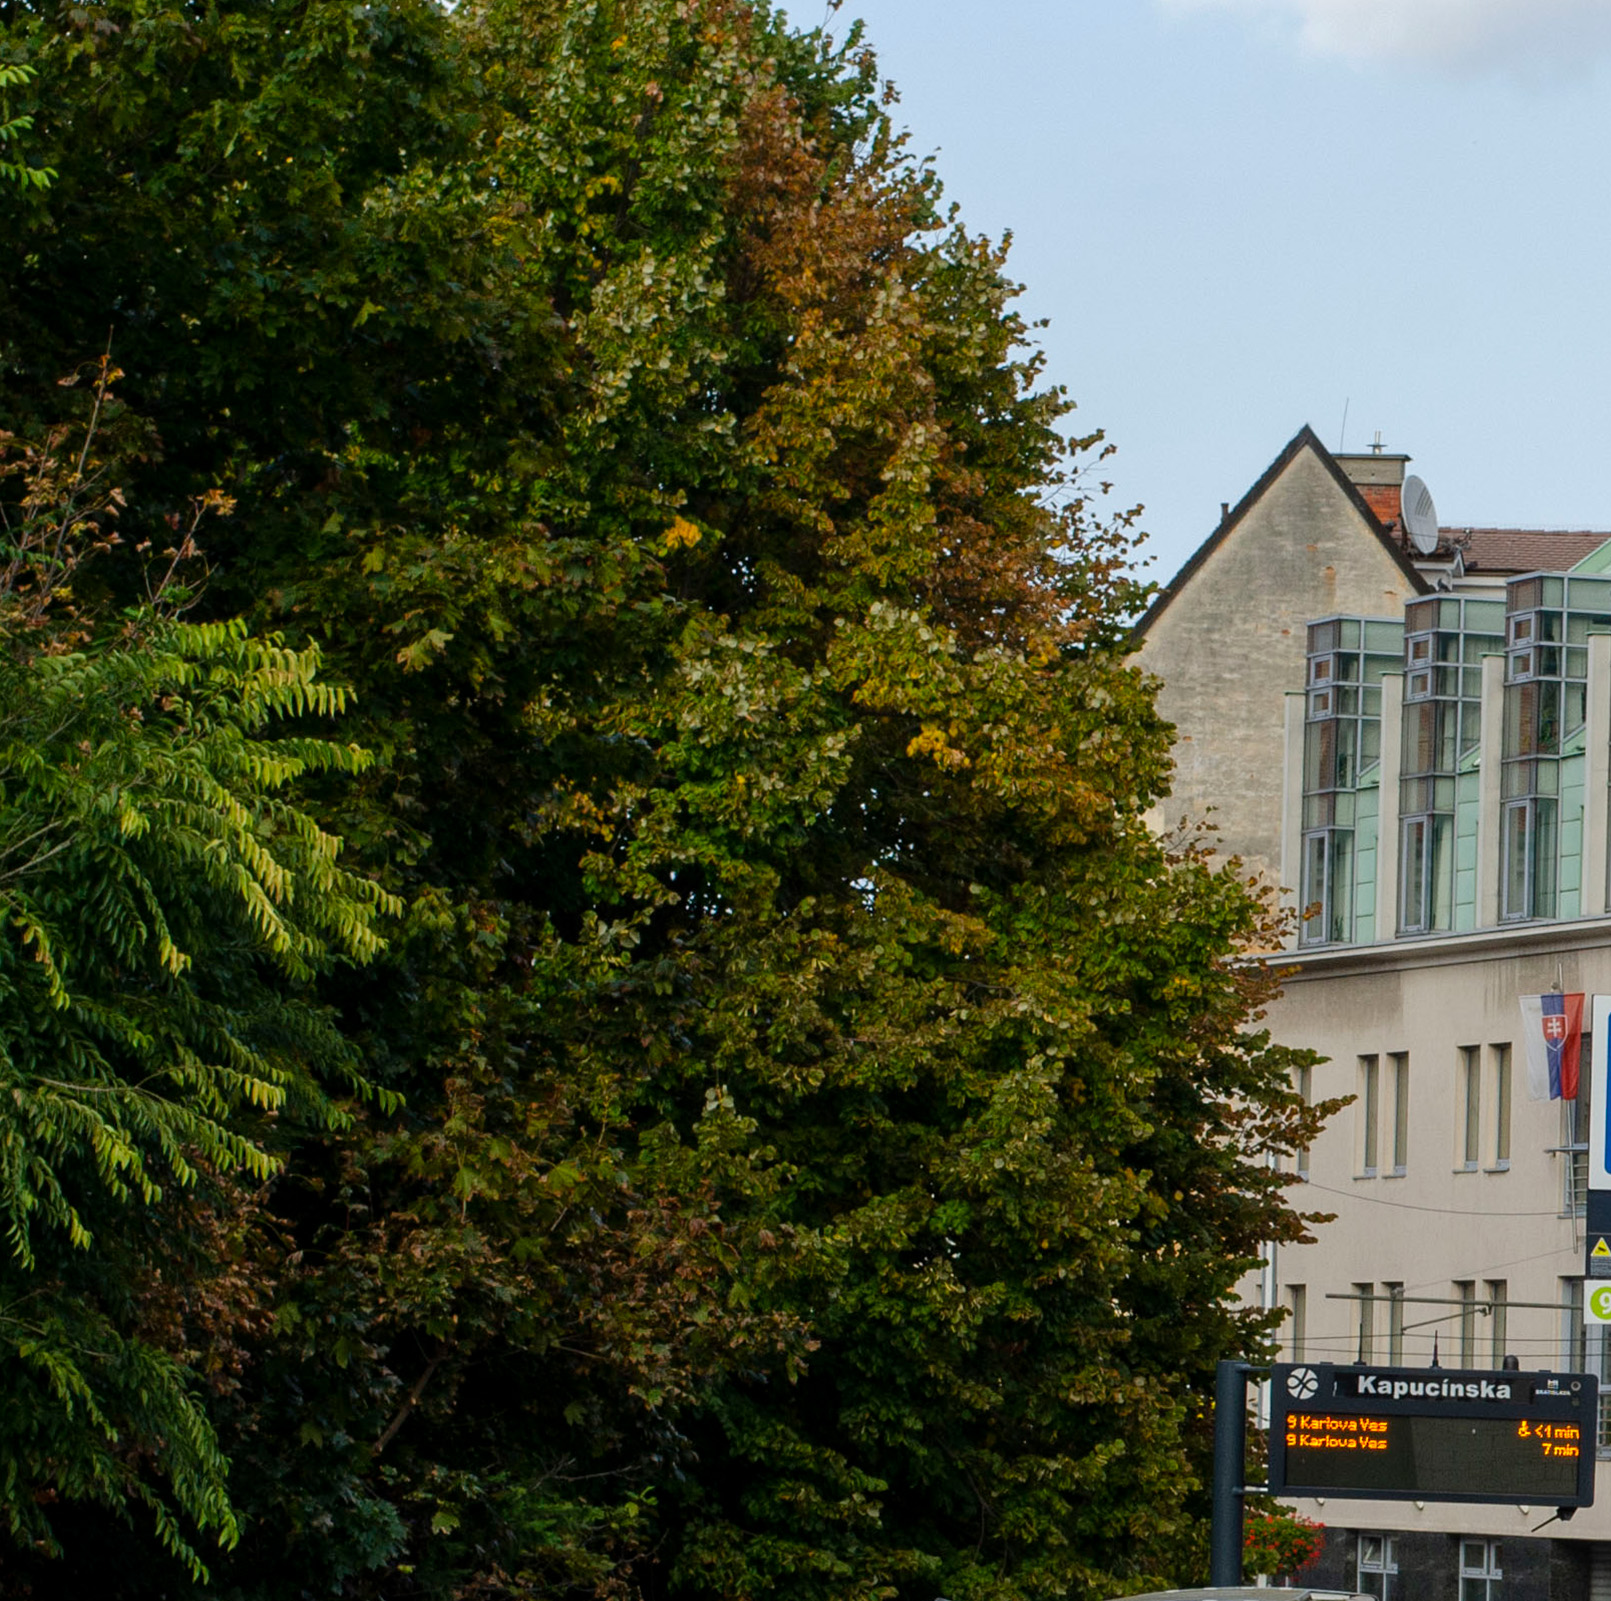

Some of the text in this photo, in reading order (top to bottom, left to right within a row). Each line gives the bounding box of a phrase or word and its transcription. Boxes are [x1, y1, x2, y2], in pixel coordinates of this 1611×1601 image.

[1357, 1374, 1512, 1400] Kapucínska
[1300, 1415, 1358, 1432] Karlova
[1554, 1425, 1580, 1440] min
[1299, 1433, 1358, 1448] Karlova
[1541, 1442, 1552, 1456] 7
[1553, 1443, 1580, 1457] min
